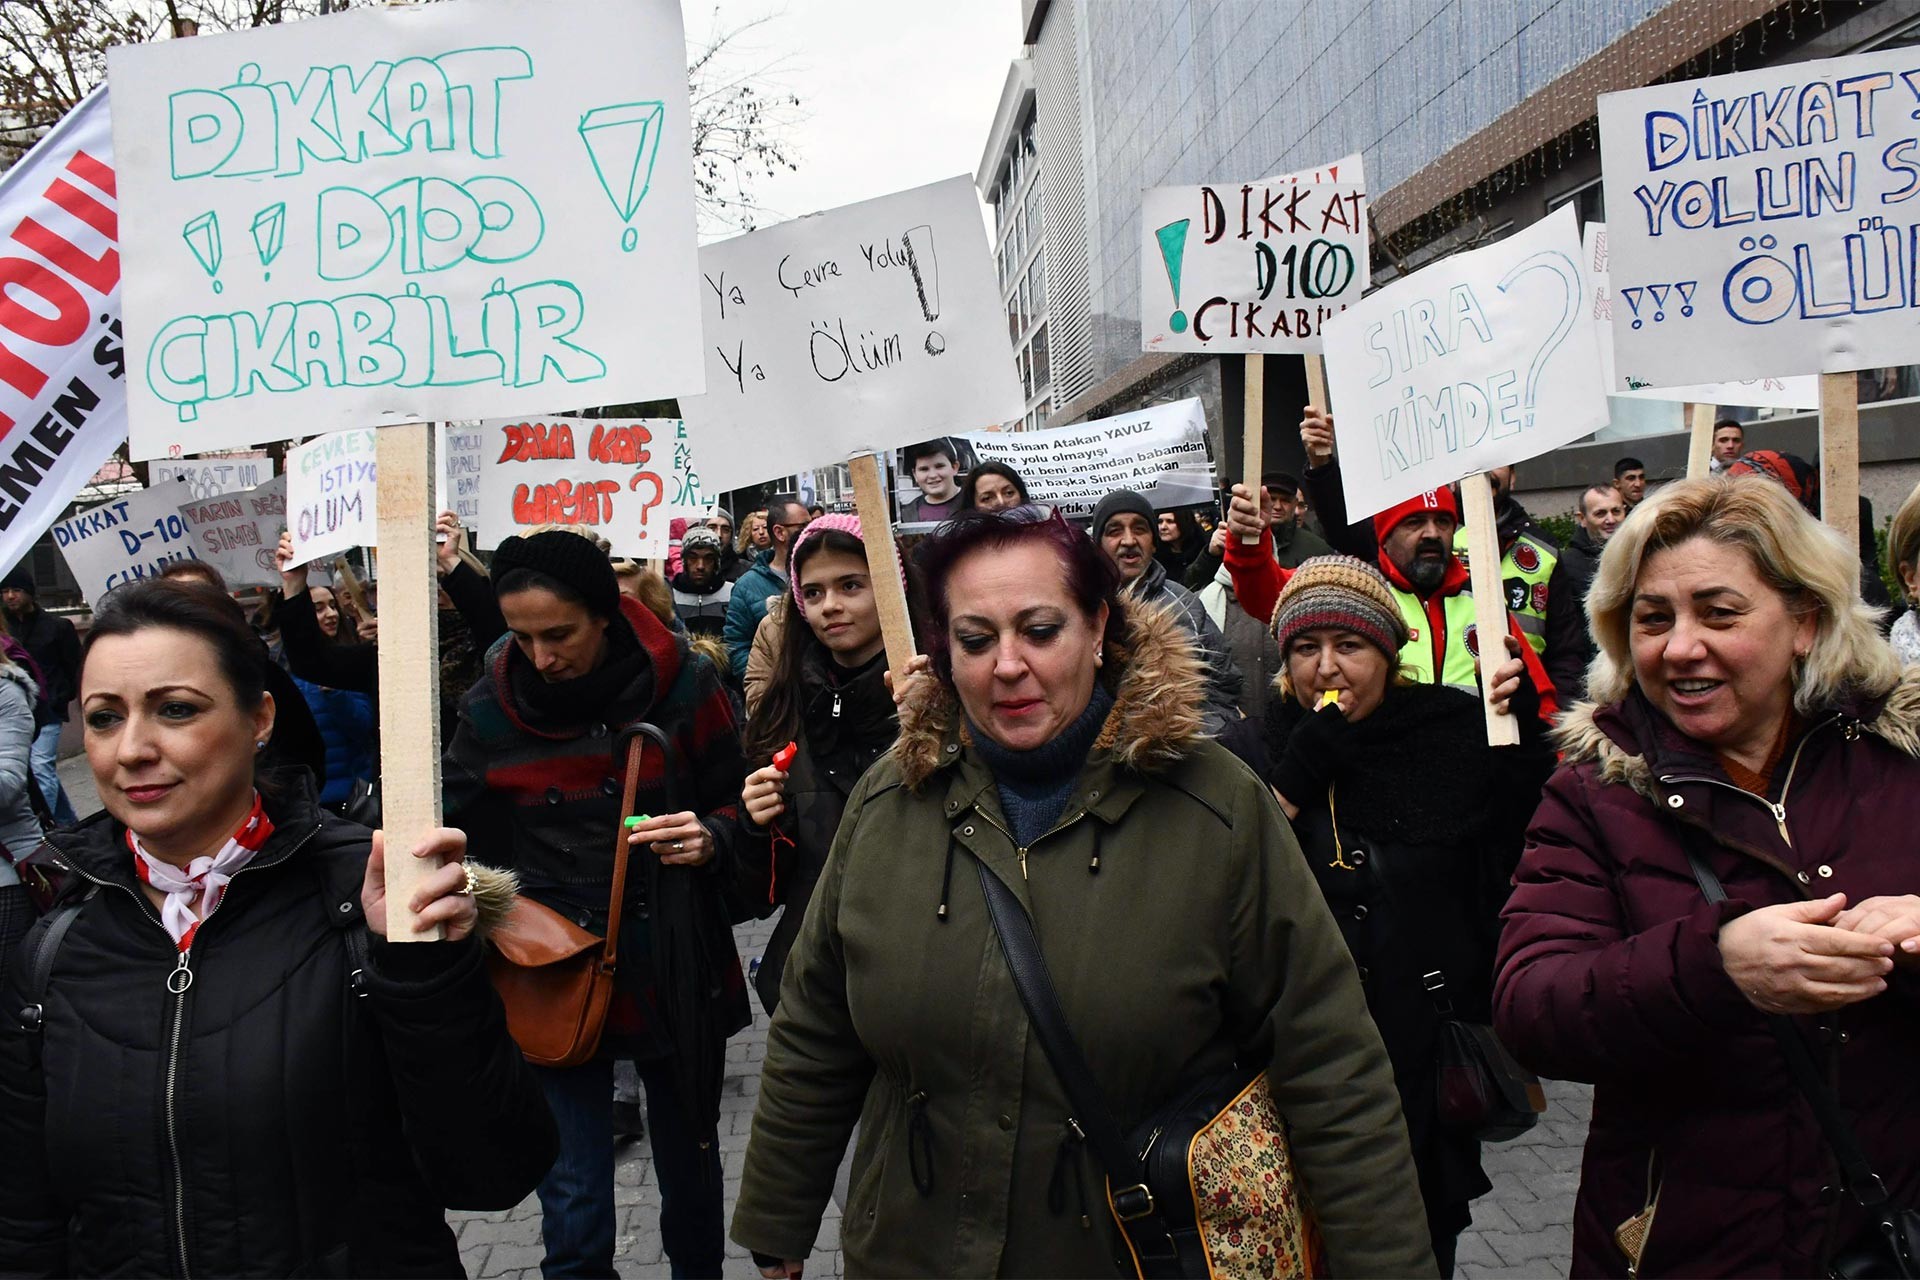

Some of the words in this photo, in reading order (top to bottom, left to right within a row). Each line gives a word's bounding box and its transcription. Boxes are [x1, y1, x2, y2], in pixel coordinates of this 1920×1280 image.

[168, 46, 534, 181] DİKKAT
[1633, 151, 1856, 237] YOLUN
[317, 175, 545, 282] D100
[703, 271, 746, 320] Ya
[778, 254, 842, 298] Çevre
[1255, 238, 1356, 301] D100
[1721, 215, 1920, 326] ÖLÜ
[146, 277, 607, 423] ÇIKABİLİR
[1193, 296, 1348, 347] ÇIKABİ
[1363, 283, 1493, 390] SIRA
[716, 339, 766, 394] Ya
[810, 317, 902, 382] Ölüm
[975, 441, 1008, 452] Adım
[1011, 442, 1049, 452] Sinan
[1053, 434, 1102, 450] Atakan
[1104, 420, 1153, 440] YAVUZ
[1020, 454, 1049, 466] yolu
[1039, 466, 1068, 476] beni
[1071, 456, 1134, 474] anamdan
[1136, 441, 1205, 462] babamdan
[1045, 477, 1087, 489] başka
[1089, 470, 1129, 484] Sinan
[1132, 461, 1180, 478] Atakan
[1062, 486, 1104, 499] analar
[53, 501, 130, 548] DİKKAT
[118, 514, 190, 557] D-10
